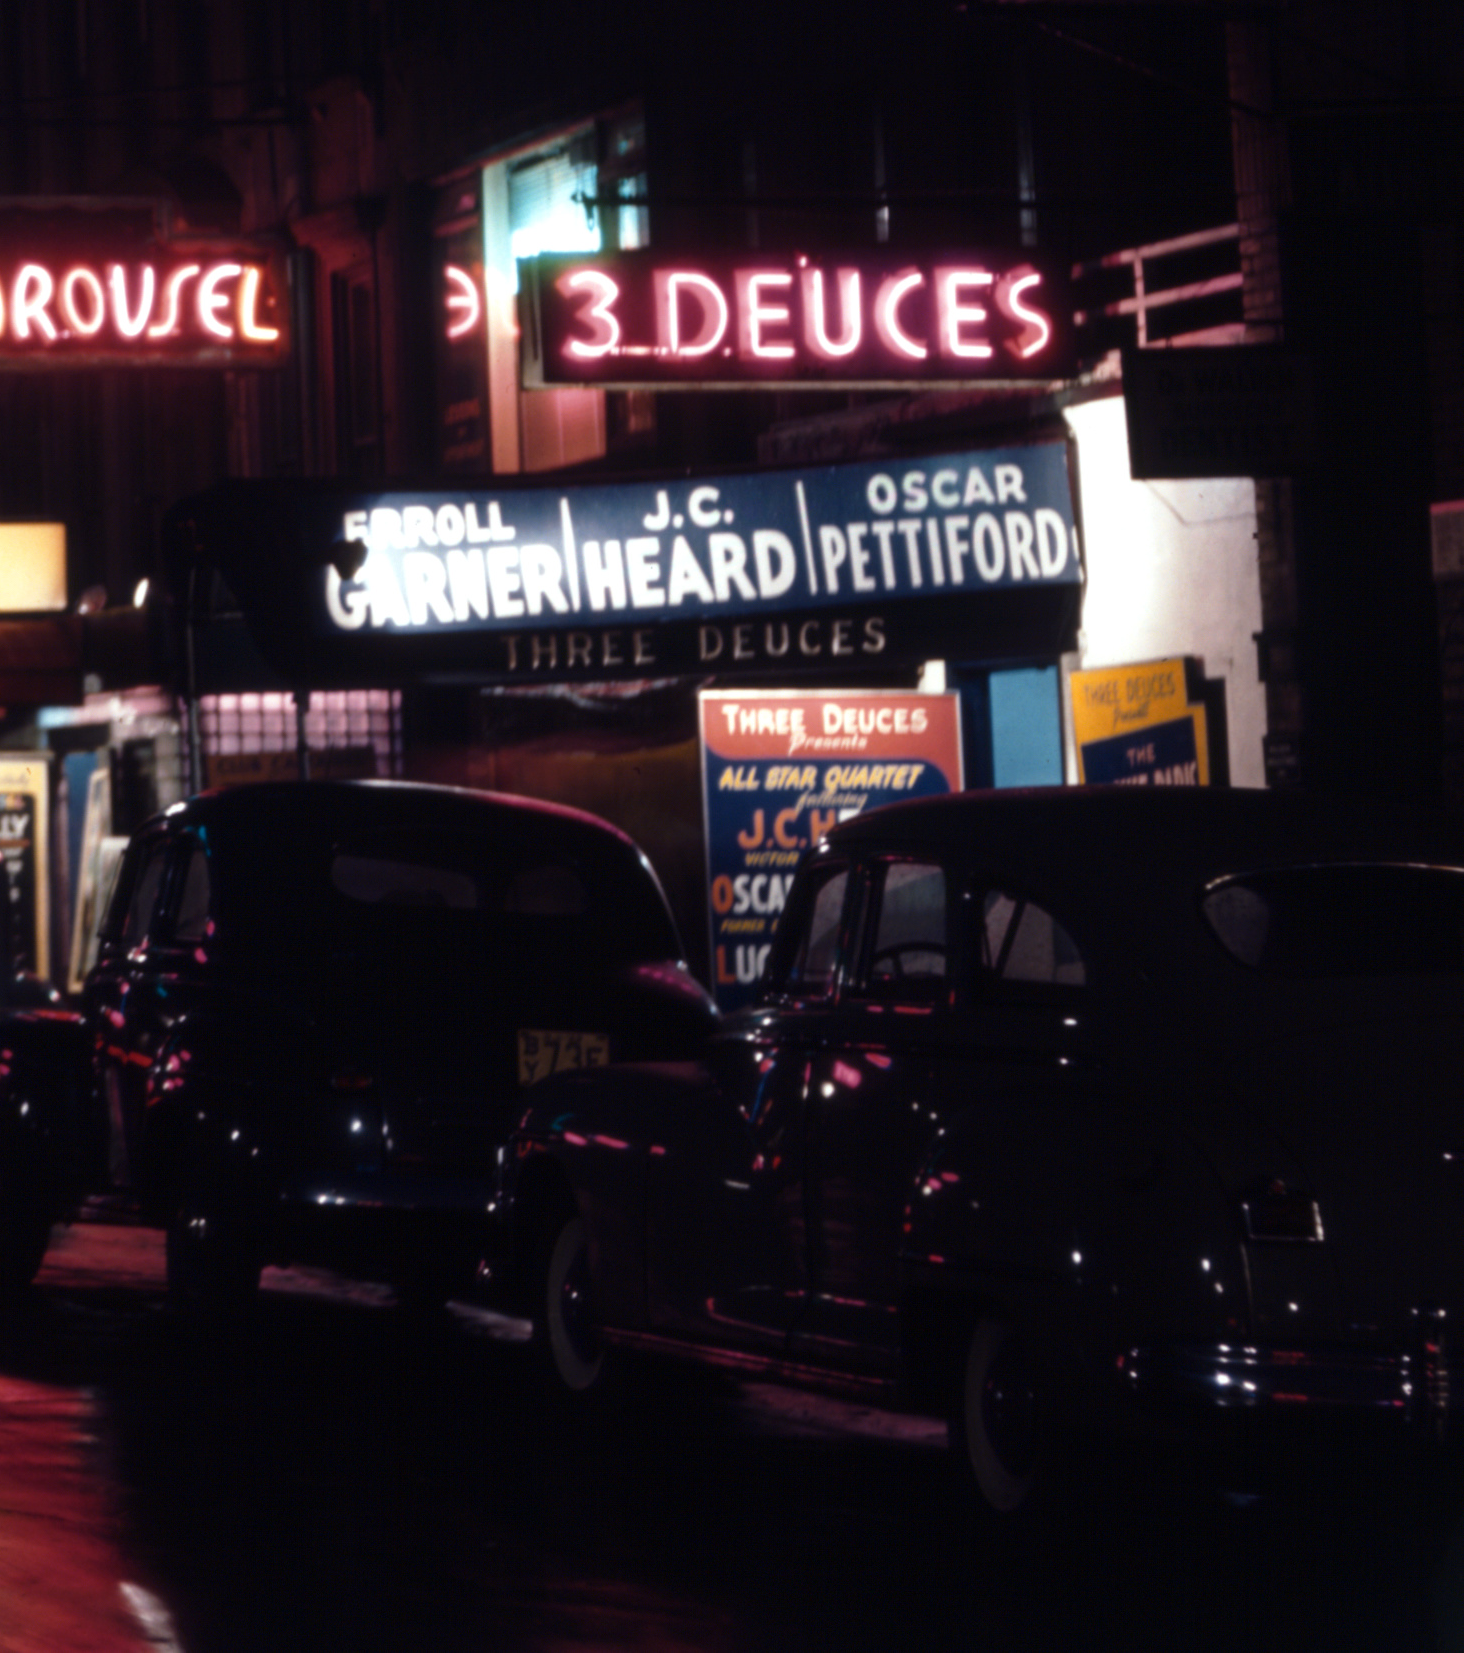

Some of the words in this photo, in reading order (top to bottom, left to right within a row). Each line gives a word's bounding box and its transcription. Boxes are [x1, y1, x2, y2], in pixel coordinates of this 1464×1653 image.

[656, 267, 1050, 360] DEUCES
[644, 487, 735, 529] J.C.
[868, 464, 1027, 515] OSCAR
[344, 501, 516, 549] ERROLL
[583, 527, 796, 613] HEARD
[820, 508, 1069, 595] PETTIFORD
[327, 543, 569, 630] GARNER
[501, 628, 657, 670] THREE
[700, 617, 887, 661] DEUCES
[722, 703, 807, 736] THREE
[823, 702, 929, 735] DEUCES
[787, 730, 869, 757] Presents
[719, 765, 760, 791] ALL
[765, 765, 818, 792] STAR
[824, 763, 925, 795] QUARTET
[1126, 744, 1156, 767] THE
